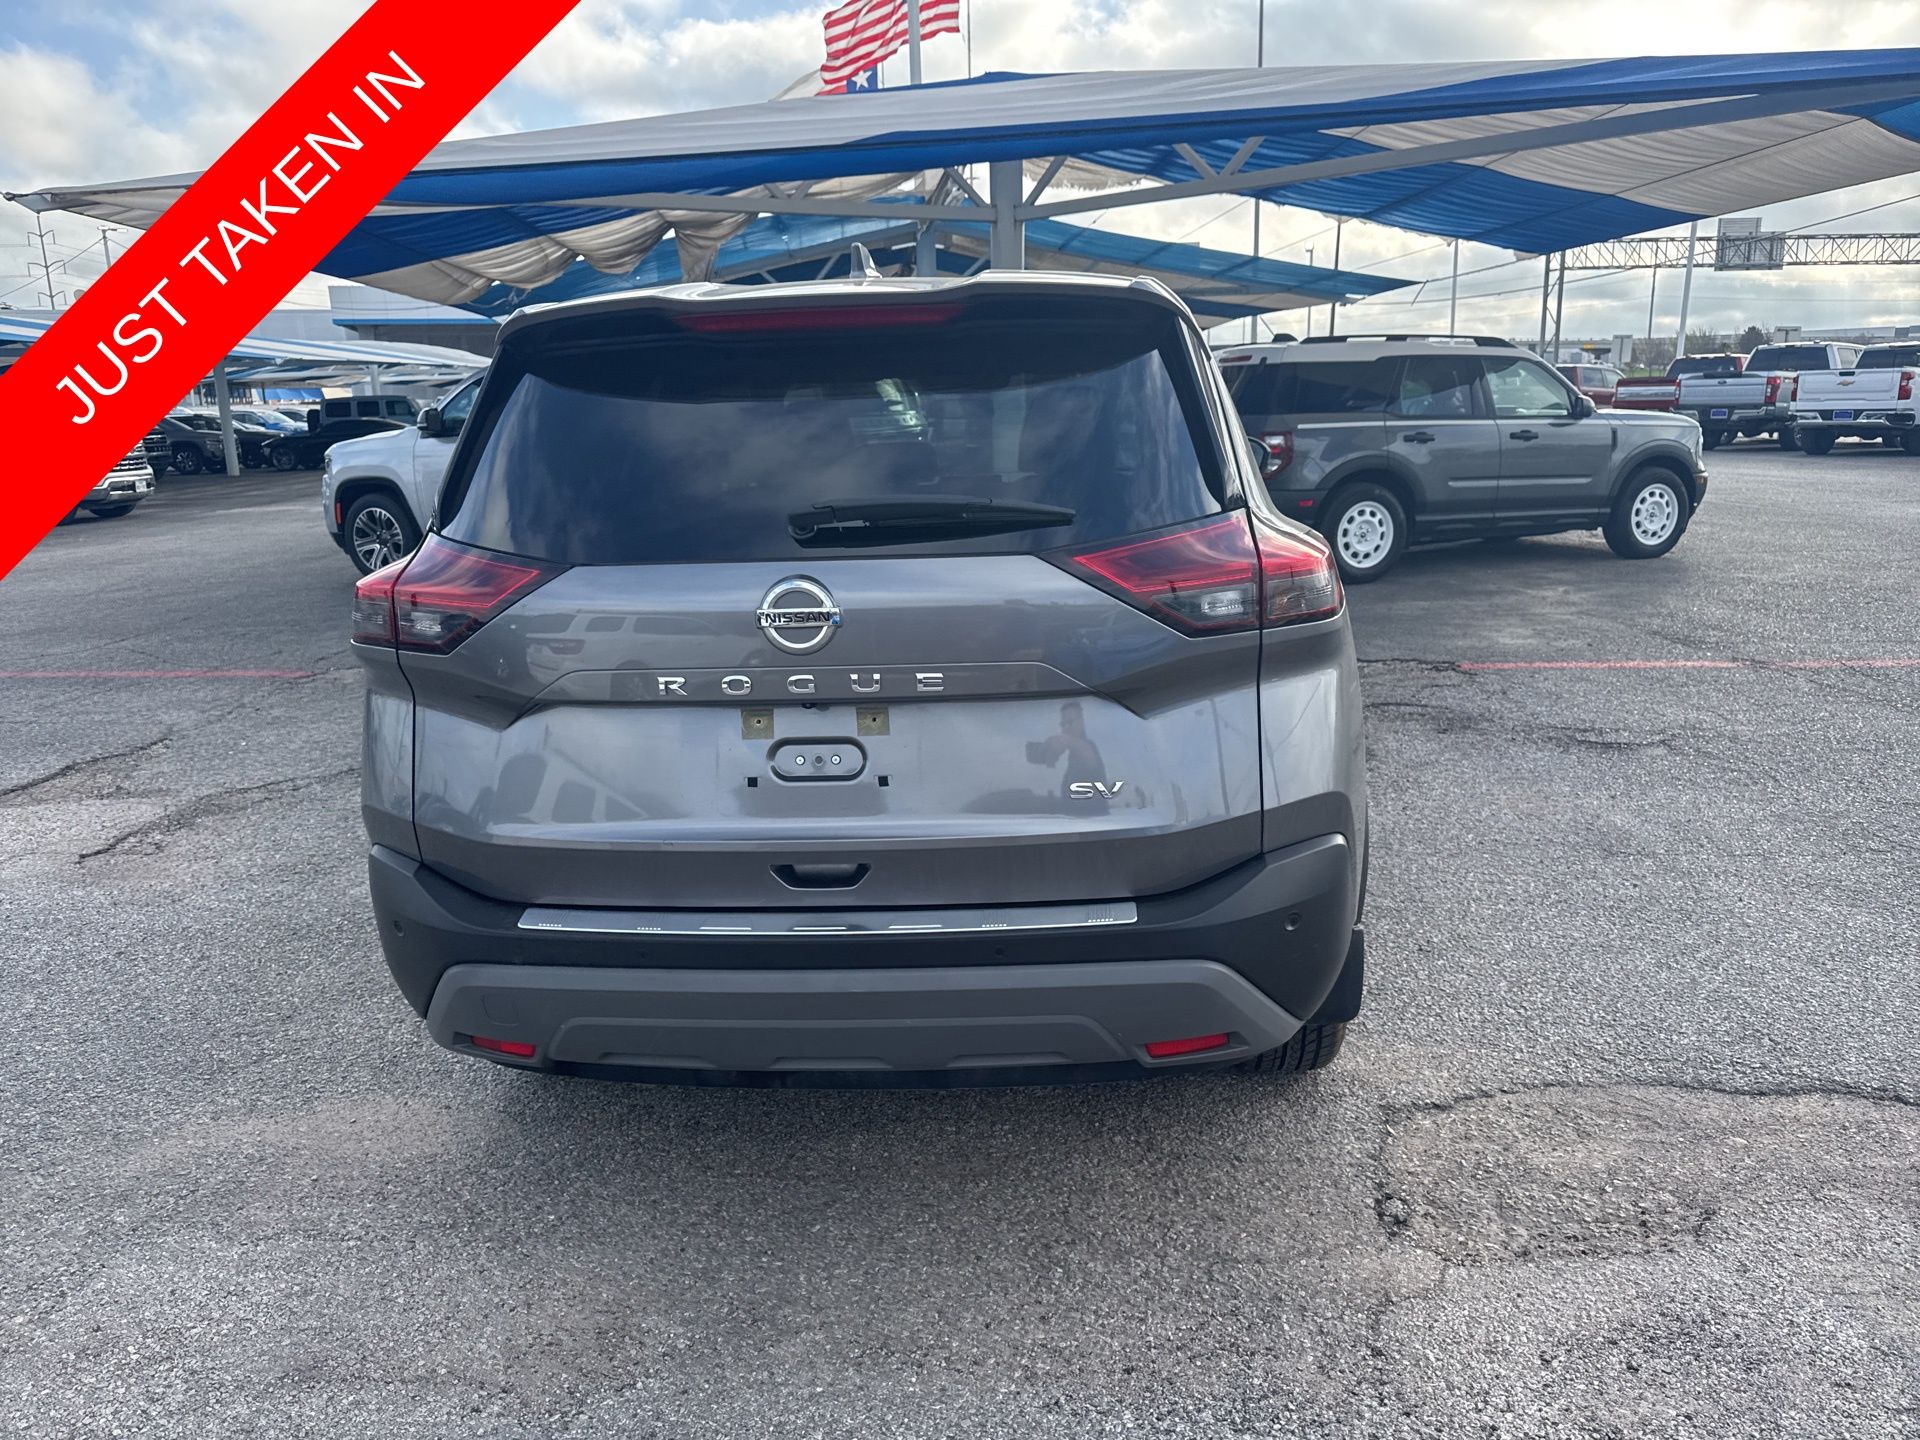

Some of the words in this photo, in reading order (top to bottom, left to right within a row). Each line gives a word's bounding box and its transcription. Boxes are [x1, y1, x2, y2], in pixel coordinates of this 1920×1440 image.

[764, 611, 831, 624] NISSAN
[656, 672, 944, 696] ROGUE
[1069, 780, 1125, 799] SV
